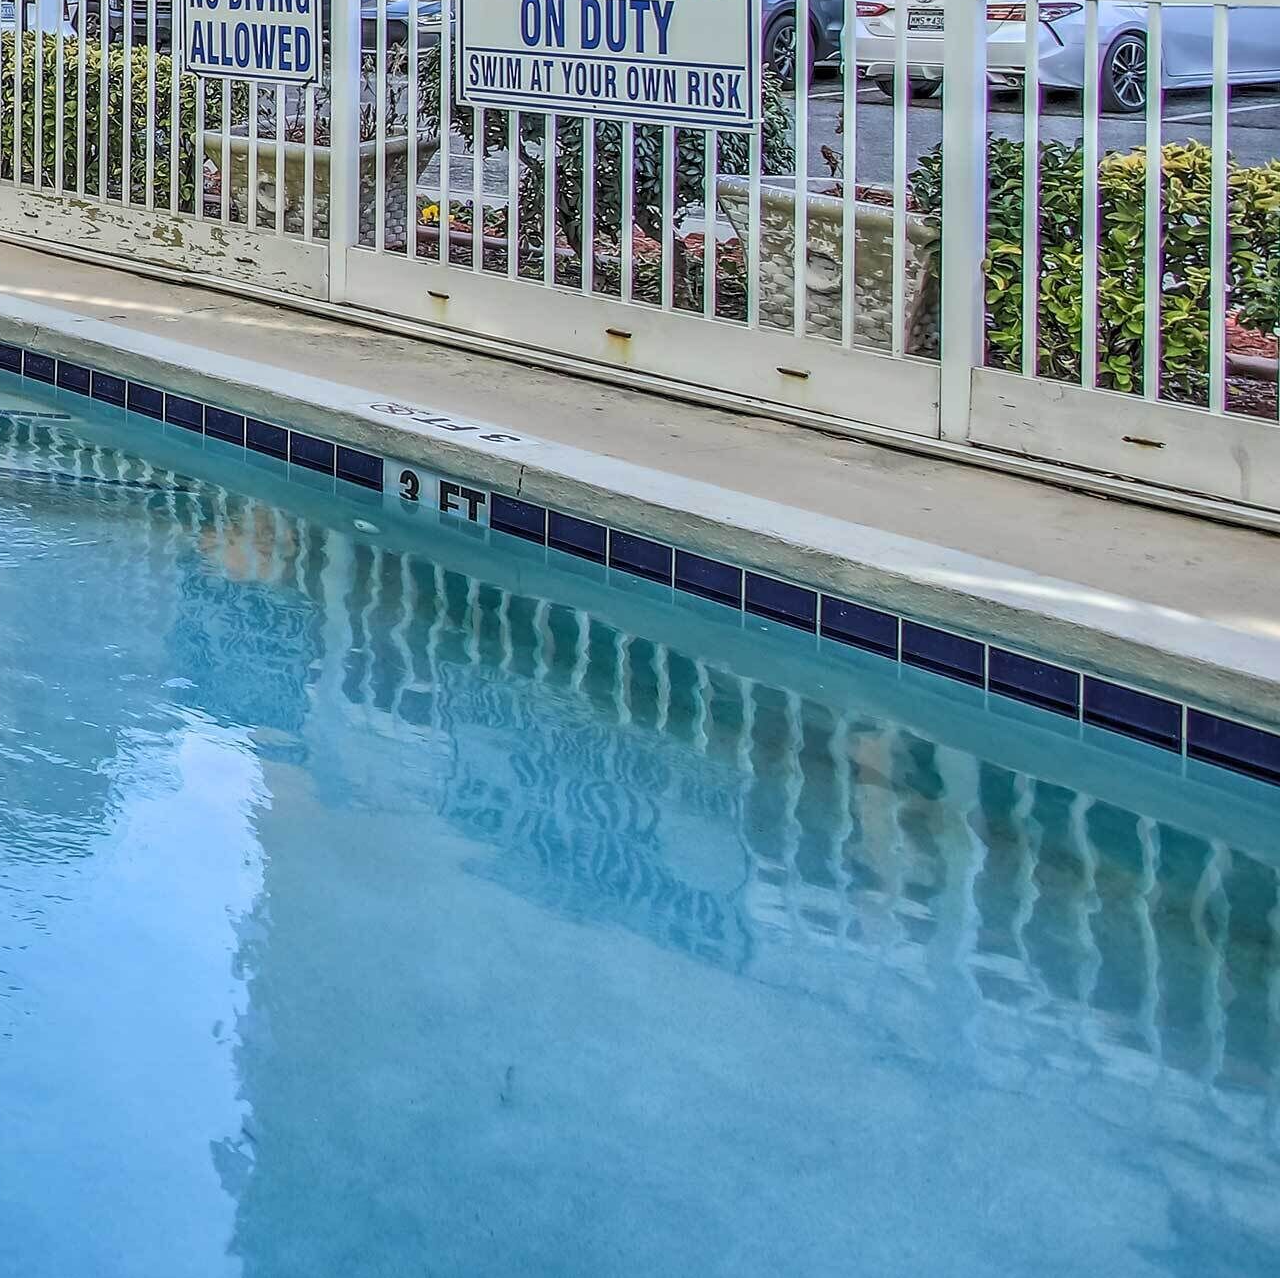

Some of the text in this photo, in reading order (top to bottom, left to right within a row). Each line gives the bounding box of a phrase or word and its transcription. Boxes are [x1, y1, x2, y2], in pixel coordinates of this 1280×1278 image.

[190, 20, 311, 72] ALLOWED
[469, 54, 742, 109] SWIM AT YOUR OWN RISK
[399, 469, 486, 523] 3 FT
